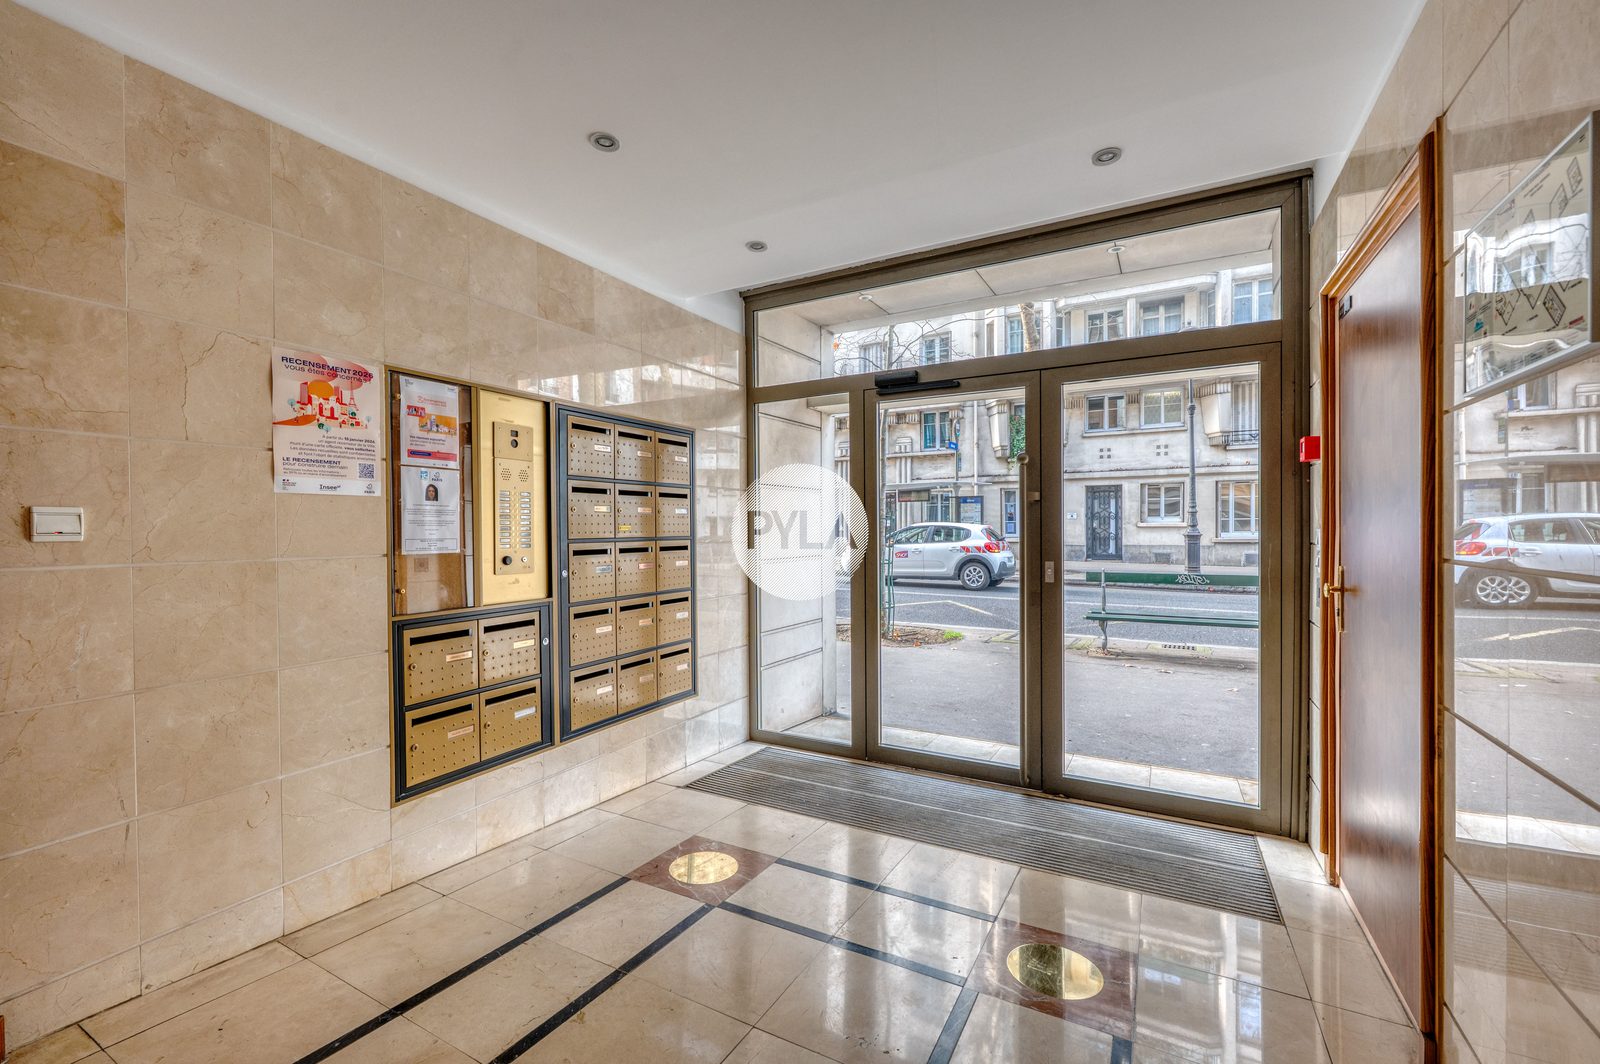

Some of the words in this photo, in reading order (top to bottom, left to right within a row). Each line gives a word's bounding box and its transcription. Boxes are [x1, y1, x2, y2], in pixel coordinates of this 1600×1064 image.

[282, 356, 352, 374] RECENSEMENT
[353, 370, 373, 379] 2026
[284, 364, 305, 372] vous
[308, 367, 326, 376] êtes
[327, 372, 367, 383] concernés
[292, 457, 341, 465] RECENSEMENT
